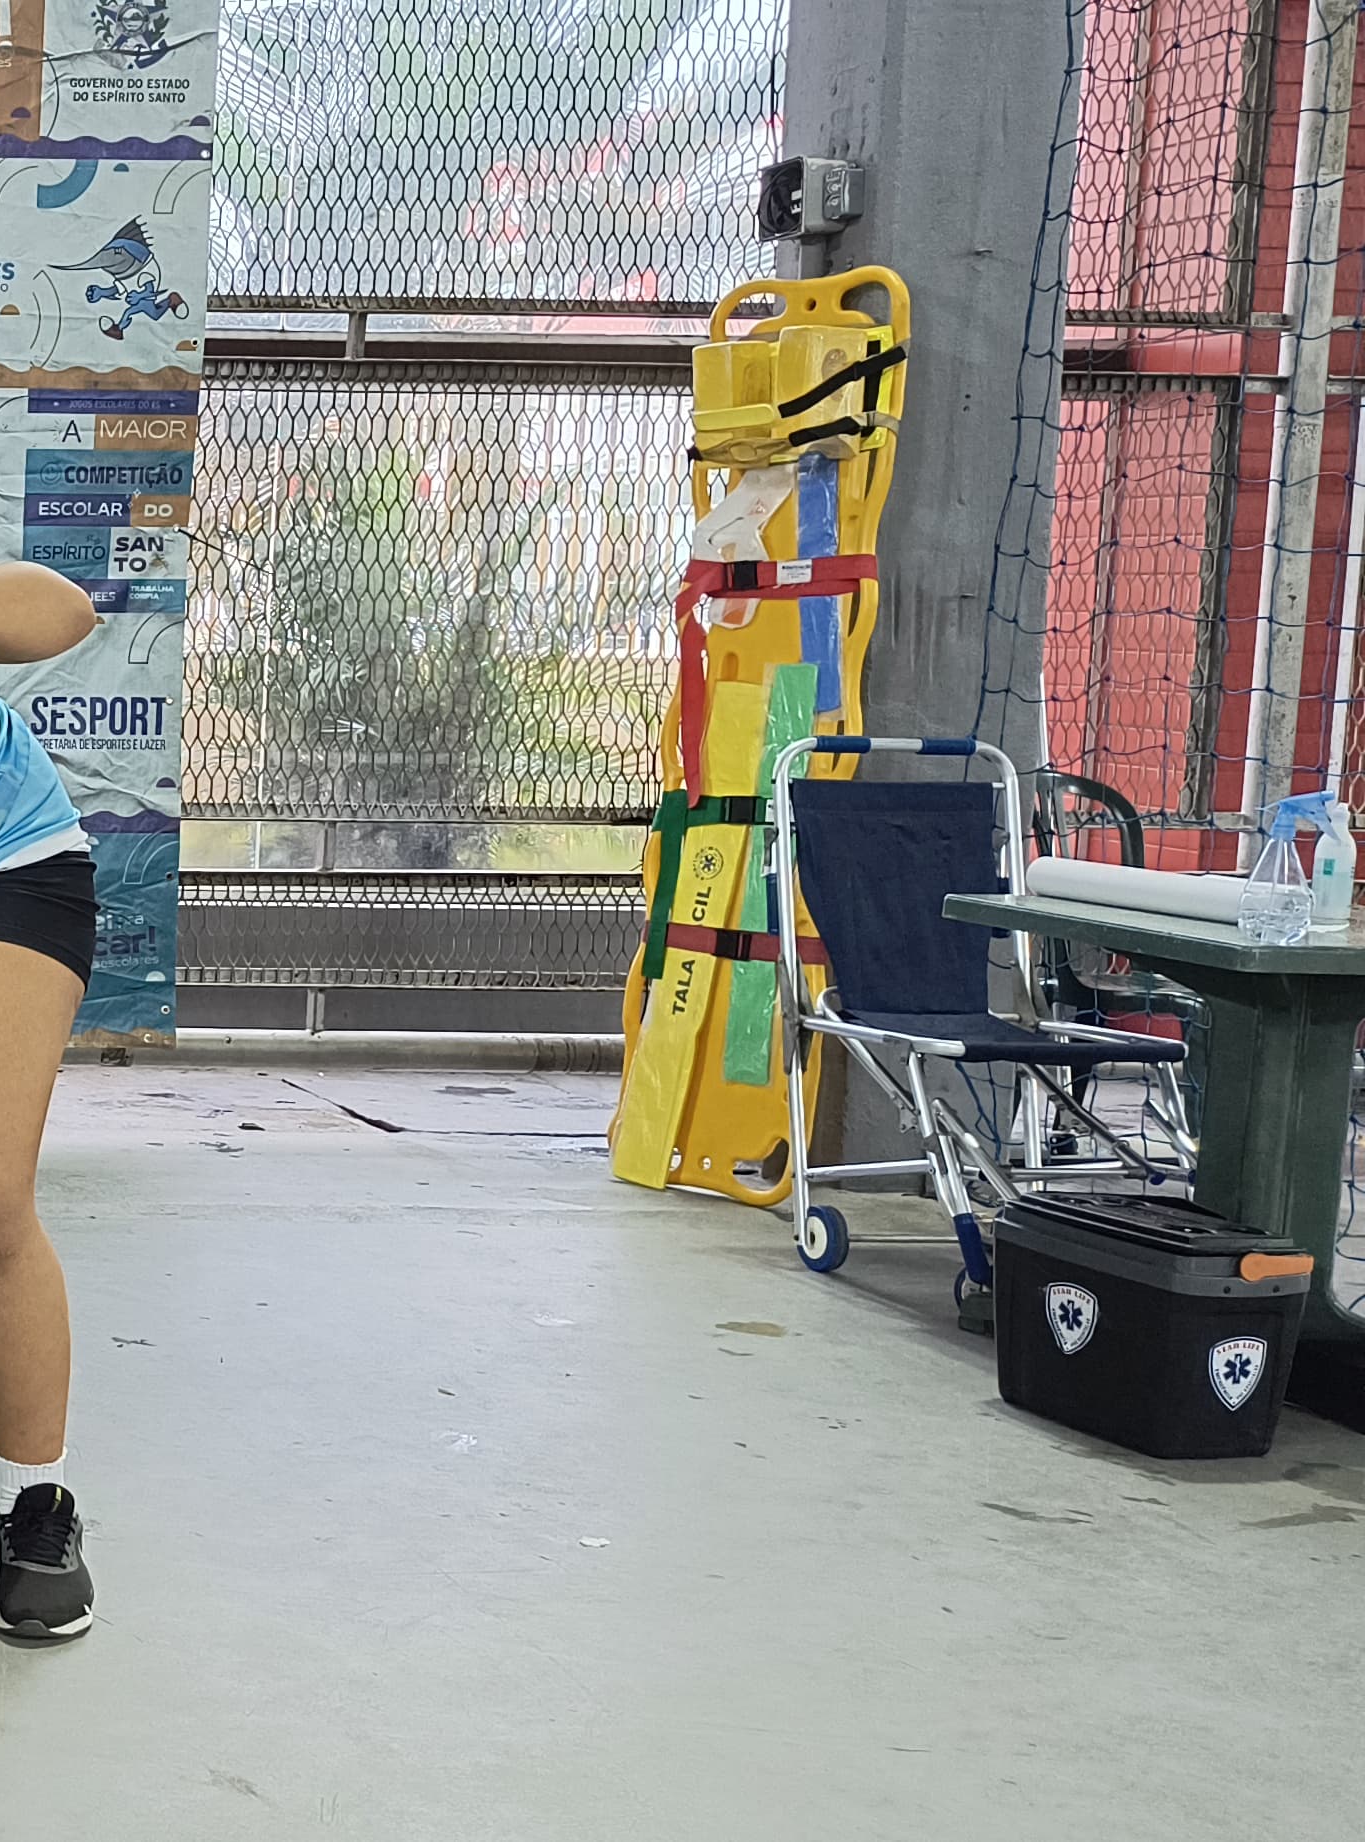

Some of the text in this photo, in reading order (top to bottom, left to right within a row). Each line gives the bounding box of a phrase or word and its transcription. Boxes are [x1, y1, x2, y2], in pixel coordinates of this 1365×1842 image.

[69, 78, 189, 89] GOVERNO DO ESTADO
[73, 90, 185, 103] DO ESPÍRITO SANTO
[61, 420, 186, 442] A MAIOR
[64, 463, 183, 488] COMPETIÇÃO
[38, 502, 173, 517] ESCOLAR DO
[32, 536, 164, 560] ESPÍRITO SAN
[114, 557, 147, 573] TO
[31, 696, 166, 735] SESPORT
[79, 739, 91, 750] DE
[91, 739, 131, 750] ESPORTES
[140, 739, 165, 750] LAZER
[691, 886, 712, 922] CIL
[94, 925, 156, 956] car!
[672, 959, 695, 1016] TALA
